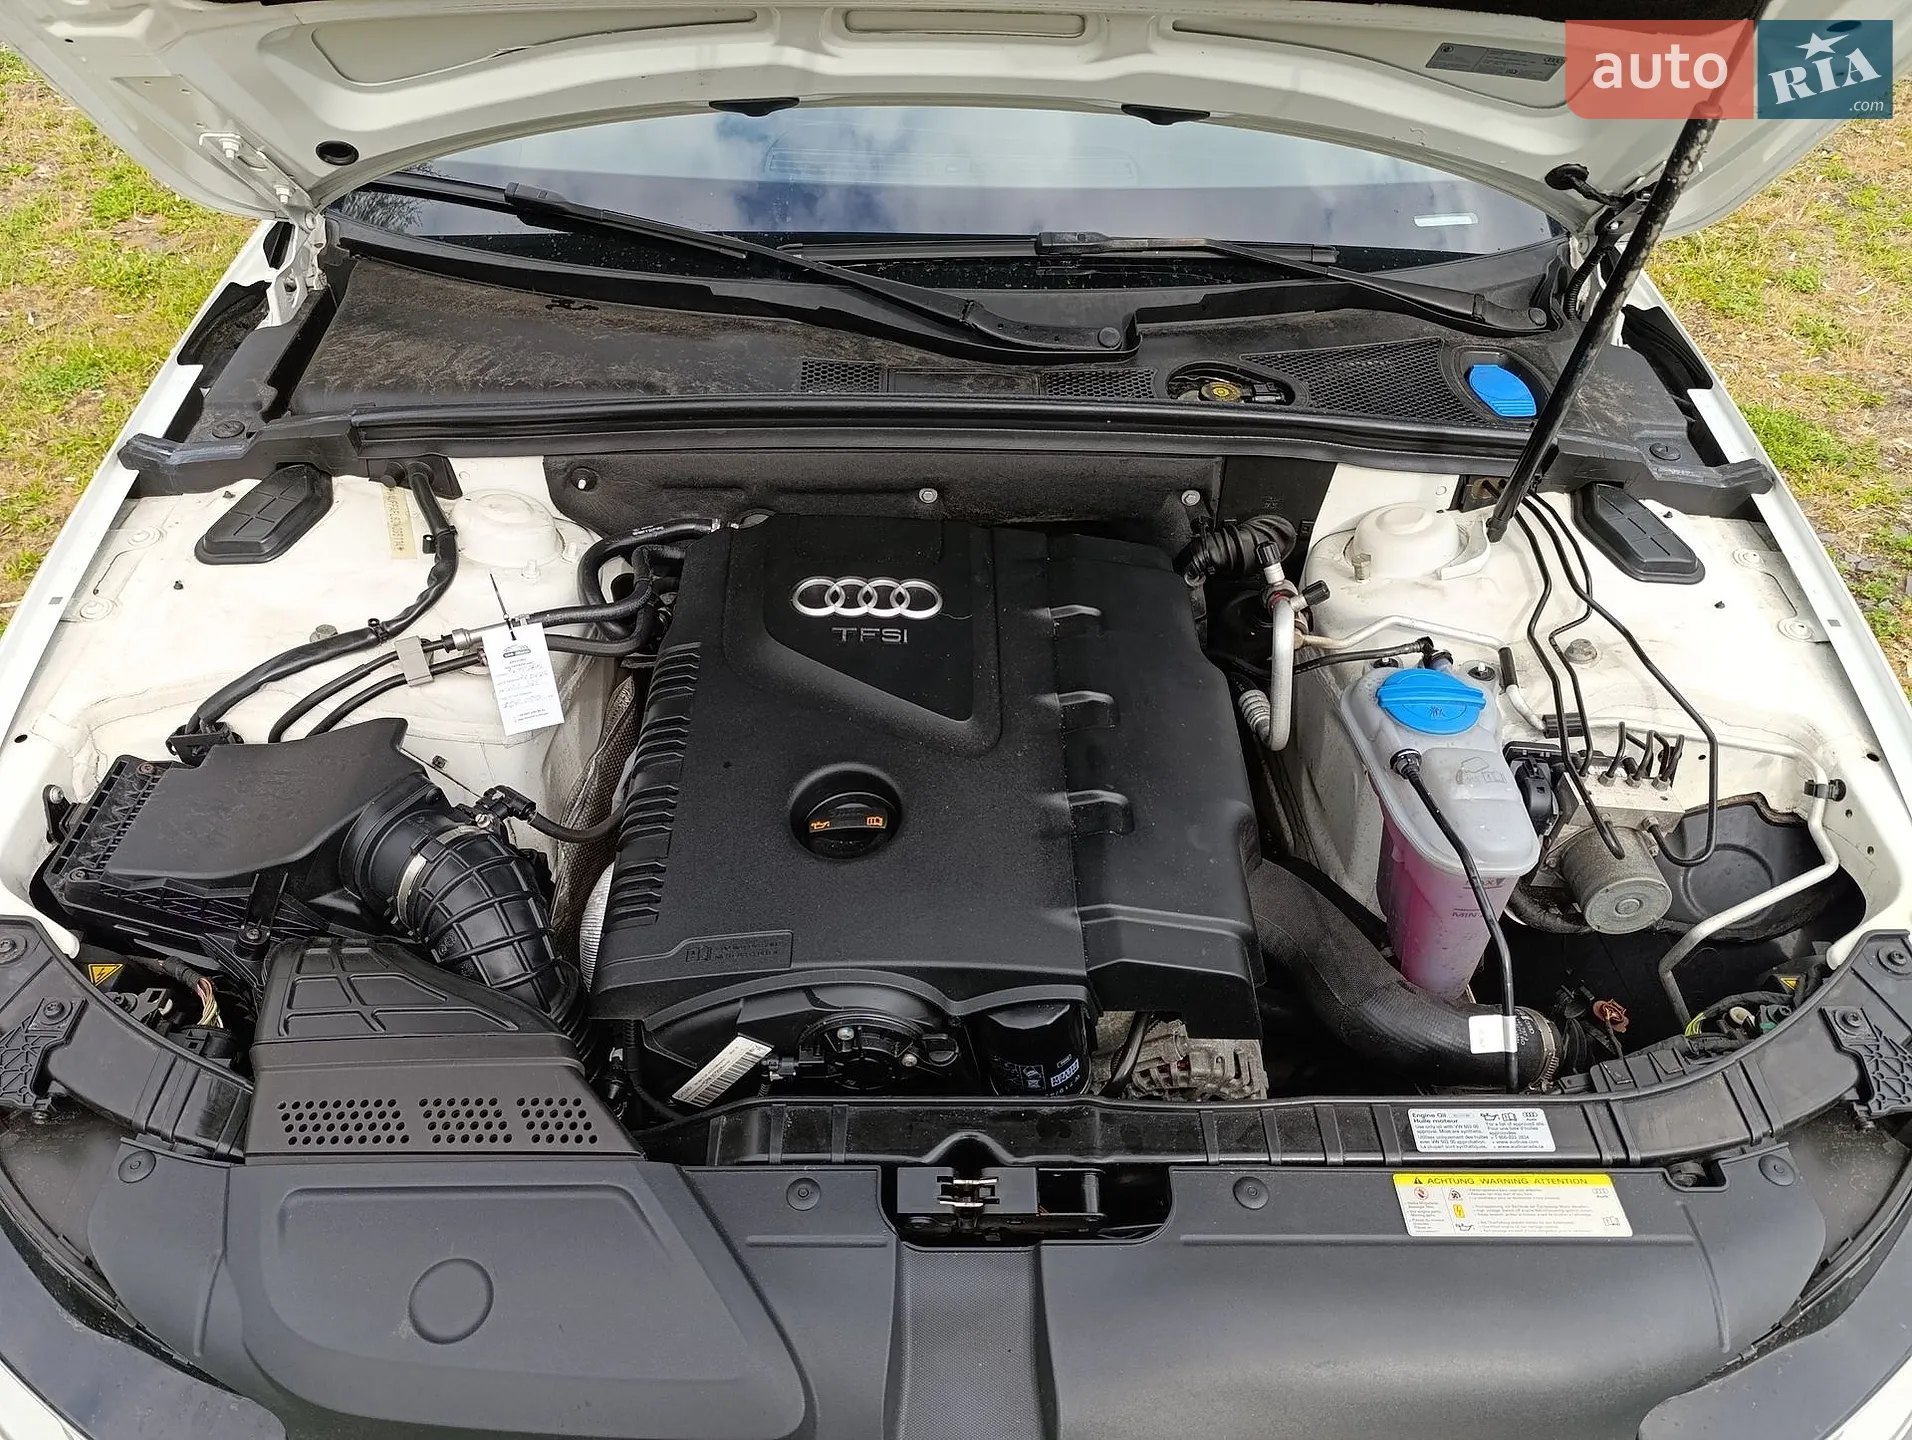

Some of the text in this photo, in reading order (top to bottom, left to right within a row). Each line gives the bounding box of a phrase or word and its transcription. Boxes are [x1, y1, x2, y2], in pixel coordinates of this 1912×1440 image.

[831, 626, 909, 644] TFSI
[1427, 1177, 1588, 1185] ACHTUNG WARNING ATTENTION
